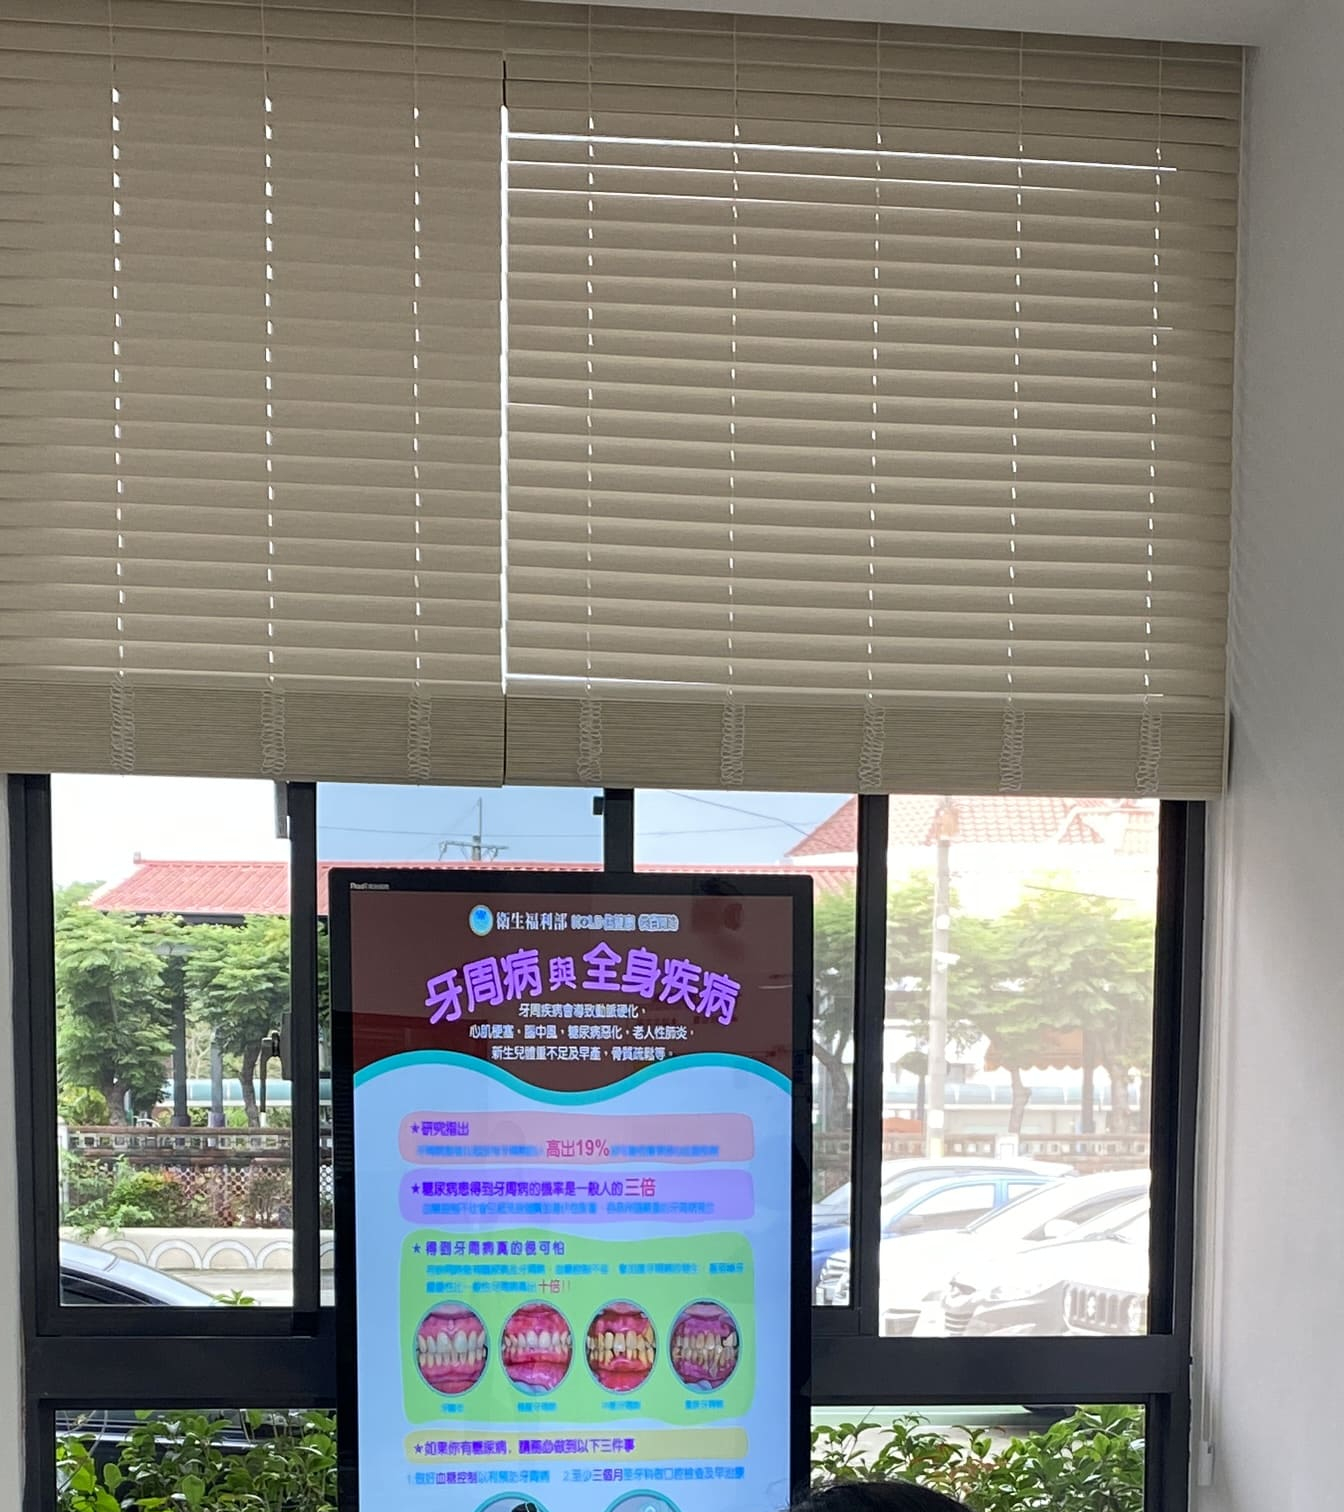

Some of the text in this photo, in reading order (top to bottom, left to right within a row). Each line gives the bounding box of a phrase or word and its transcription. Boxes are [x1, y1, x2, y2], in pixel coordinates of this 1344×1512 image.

[496, 912, 568, 930] 衛生福利部
[425, 942, 742, 1026] 牙周病與全身疾病
[546, 1138, 610, 1158] 高出19%
